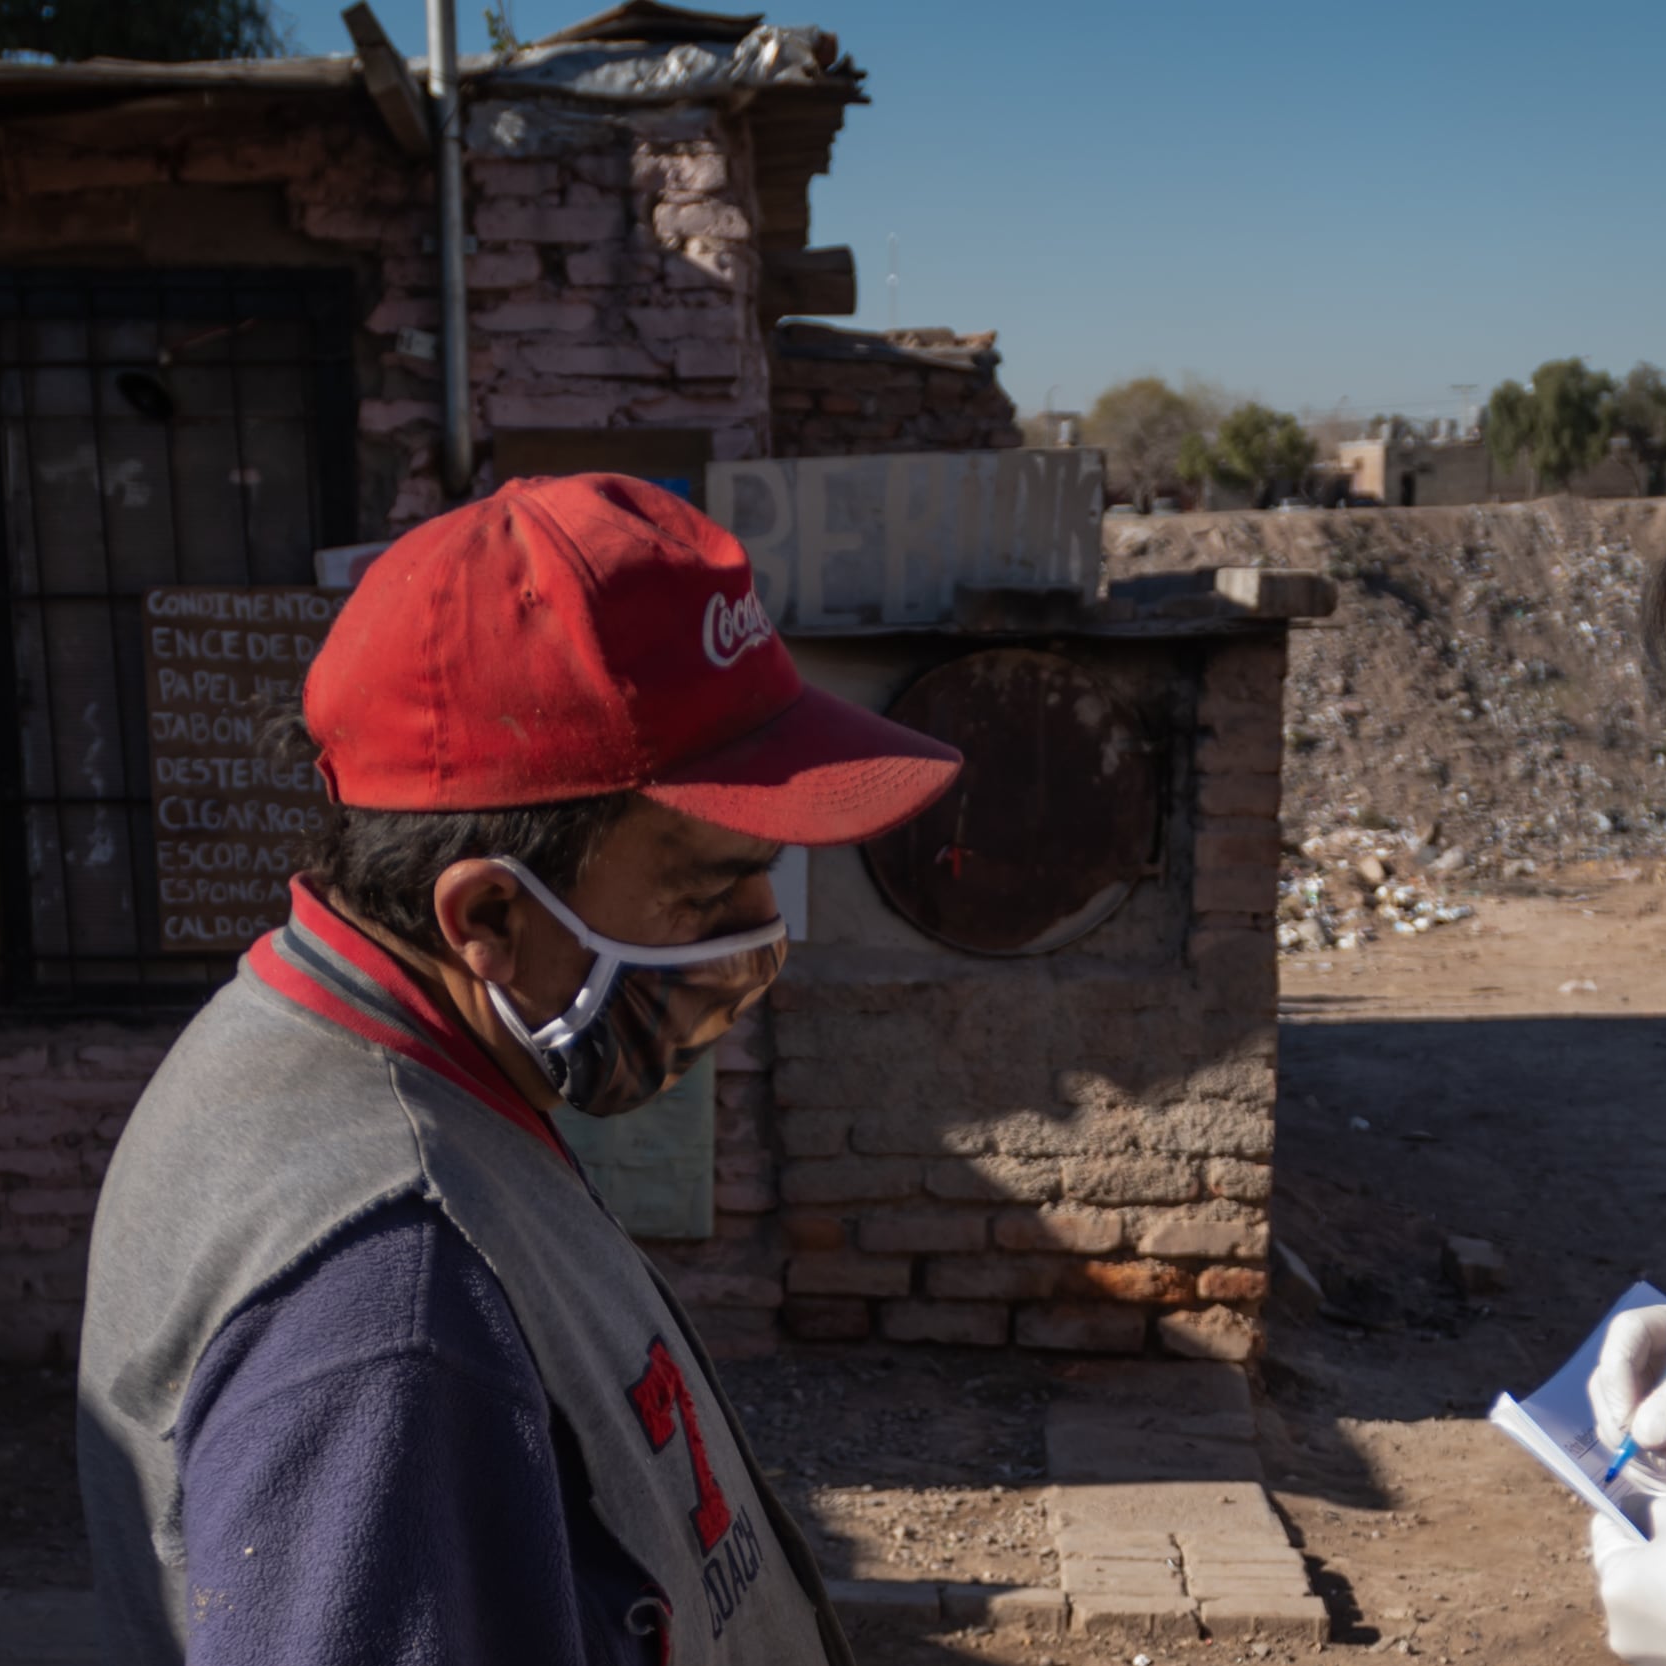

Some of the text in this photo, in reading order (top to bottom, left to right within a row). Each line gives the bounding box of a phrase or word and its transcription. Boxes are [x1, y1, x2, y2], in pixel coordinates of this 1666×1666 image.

[151, 626, 321, 664] ENCEDED
[158, 667, 247, 707] PAPEL
[151, 708, 254, 745] JABÓN
[158, 795, 323, 832] CIGARROS
[157, 841, 289, 873] ESCOBAS
[700, 1503, 763, 1641] COACH
